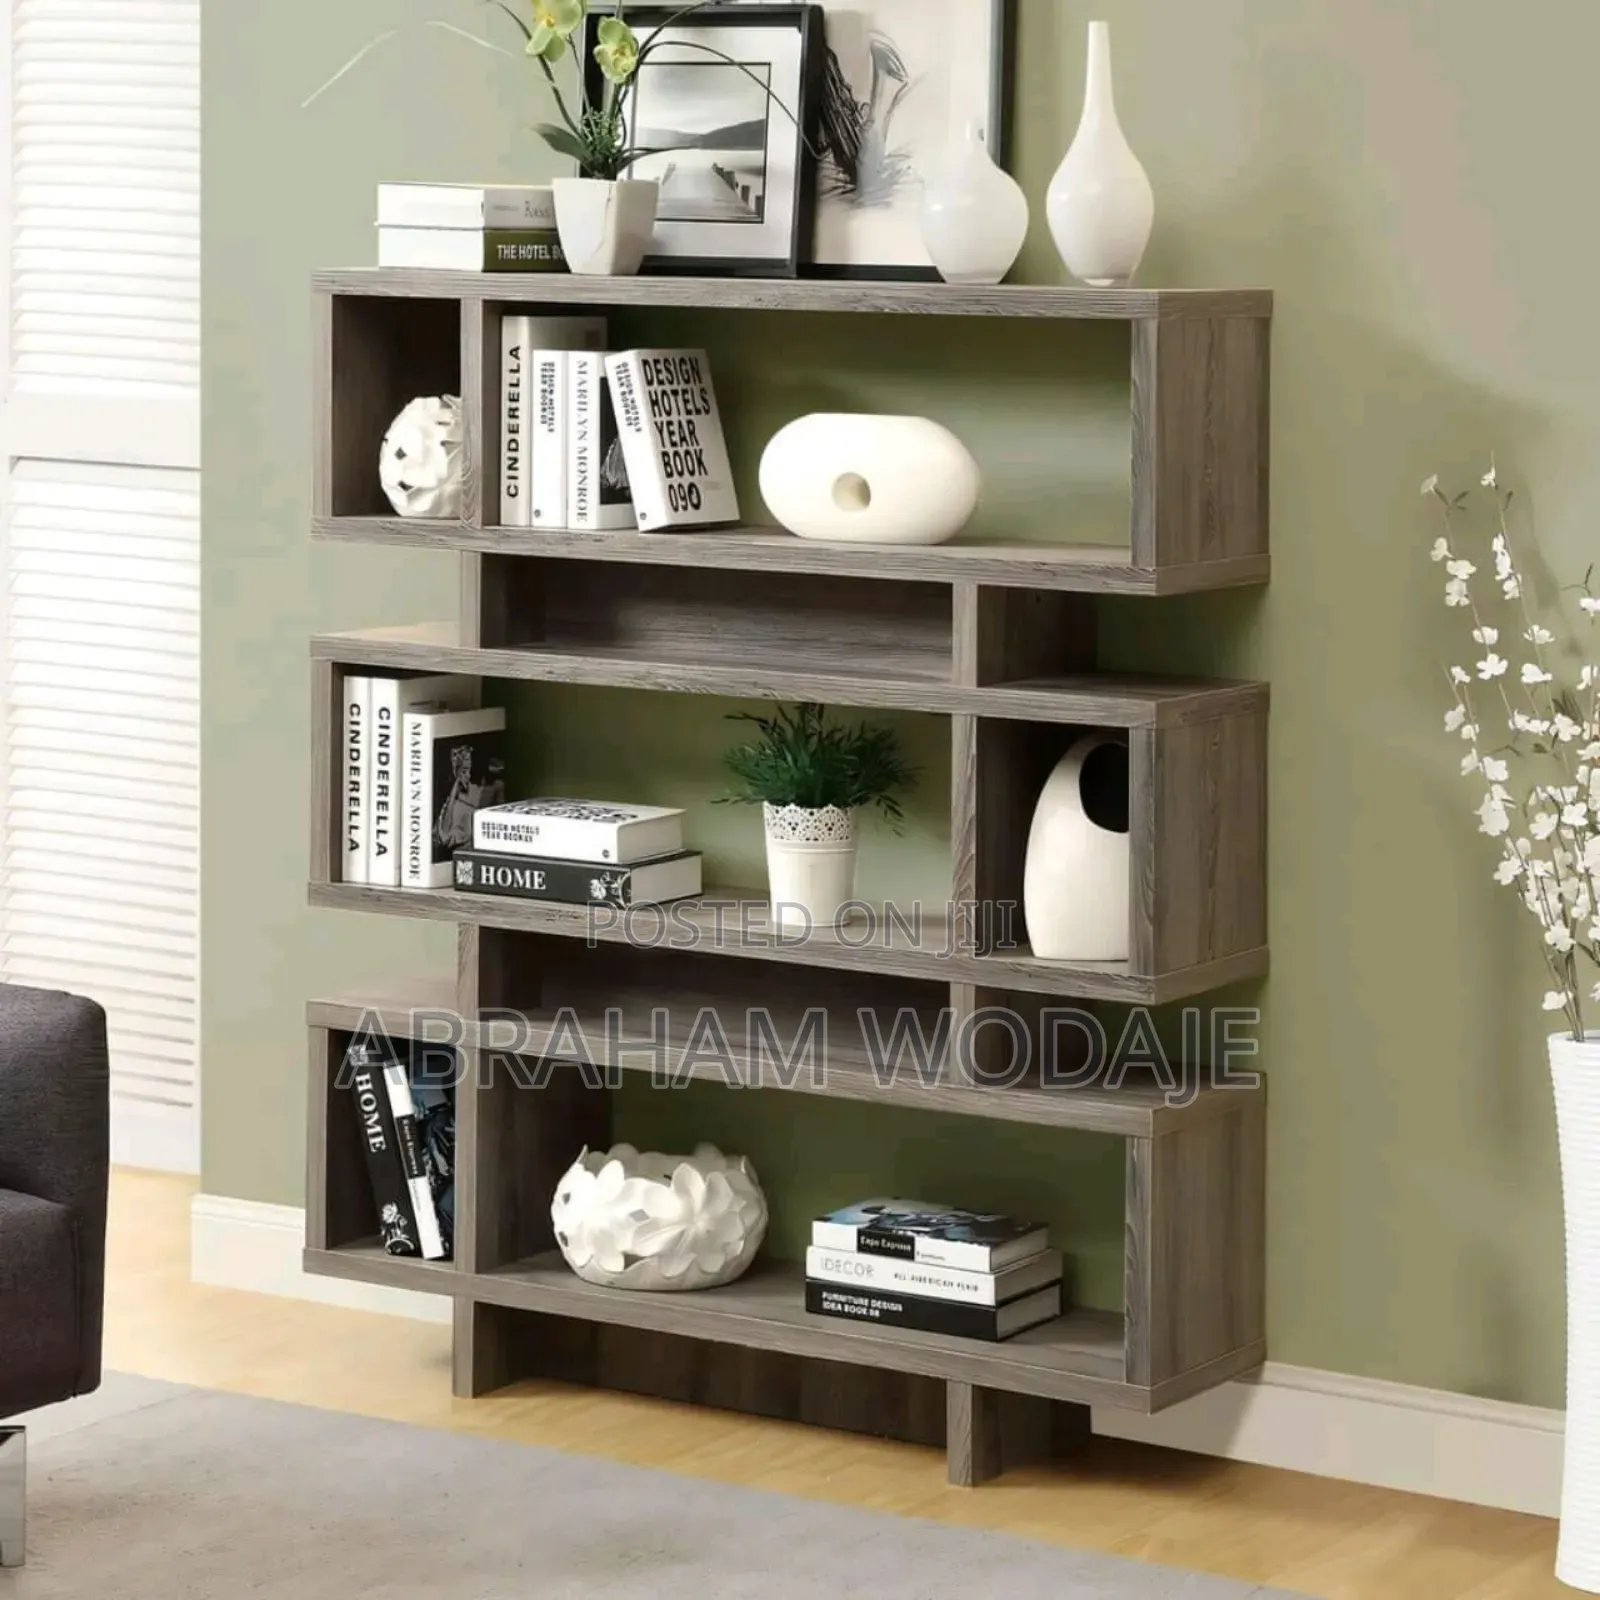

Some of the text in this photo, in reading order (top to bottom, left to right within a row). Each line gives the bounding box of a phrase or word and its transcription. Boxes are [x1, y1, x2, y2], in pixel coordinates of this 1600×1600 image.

[497, 244, 518, 260] THE
[519, 244, 551, 260] HOTEL
[642, 357, 702, 387] DESIGN
[650, 387, 711, 418] HOTELS
[506, 345, 521, 498] CINDERELLA
[654, 419, 700, 449] YEAR
[576, 360, 588, 522] MARILYN MONROE
[662, 448, 708, 478] BOOK
[348, 703, 361, 852] CINDERELLA
[376, 706, 391, 856] CINDERELLA
[408, 721, 422, 880] MARILYN MONROE
[480, 867, 546, 890] HOME
[355, 1073, 387, 1153] HOME
[843, 1304, 868, 1316] BOOK
